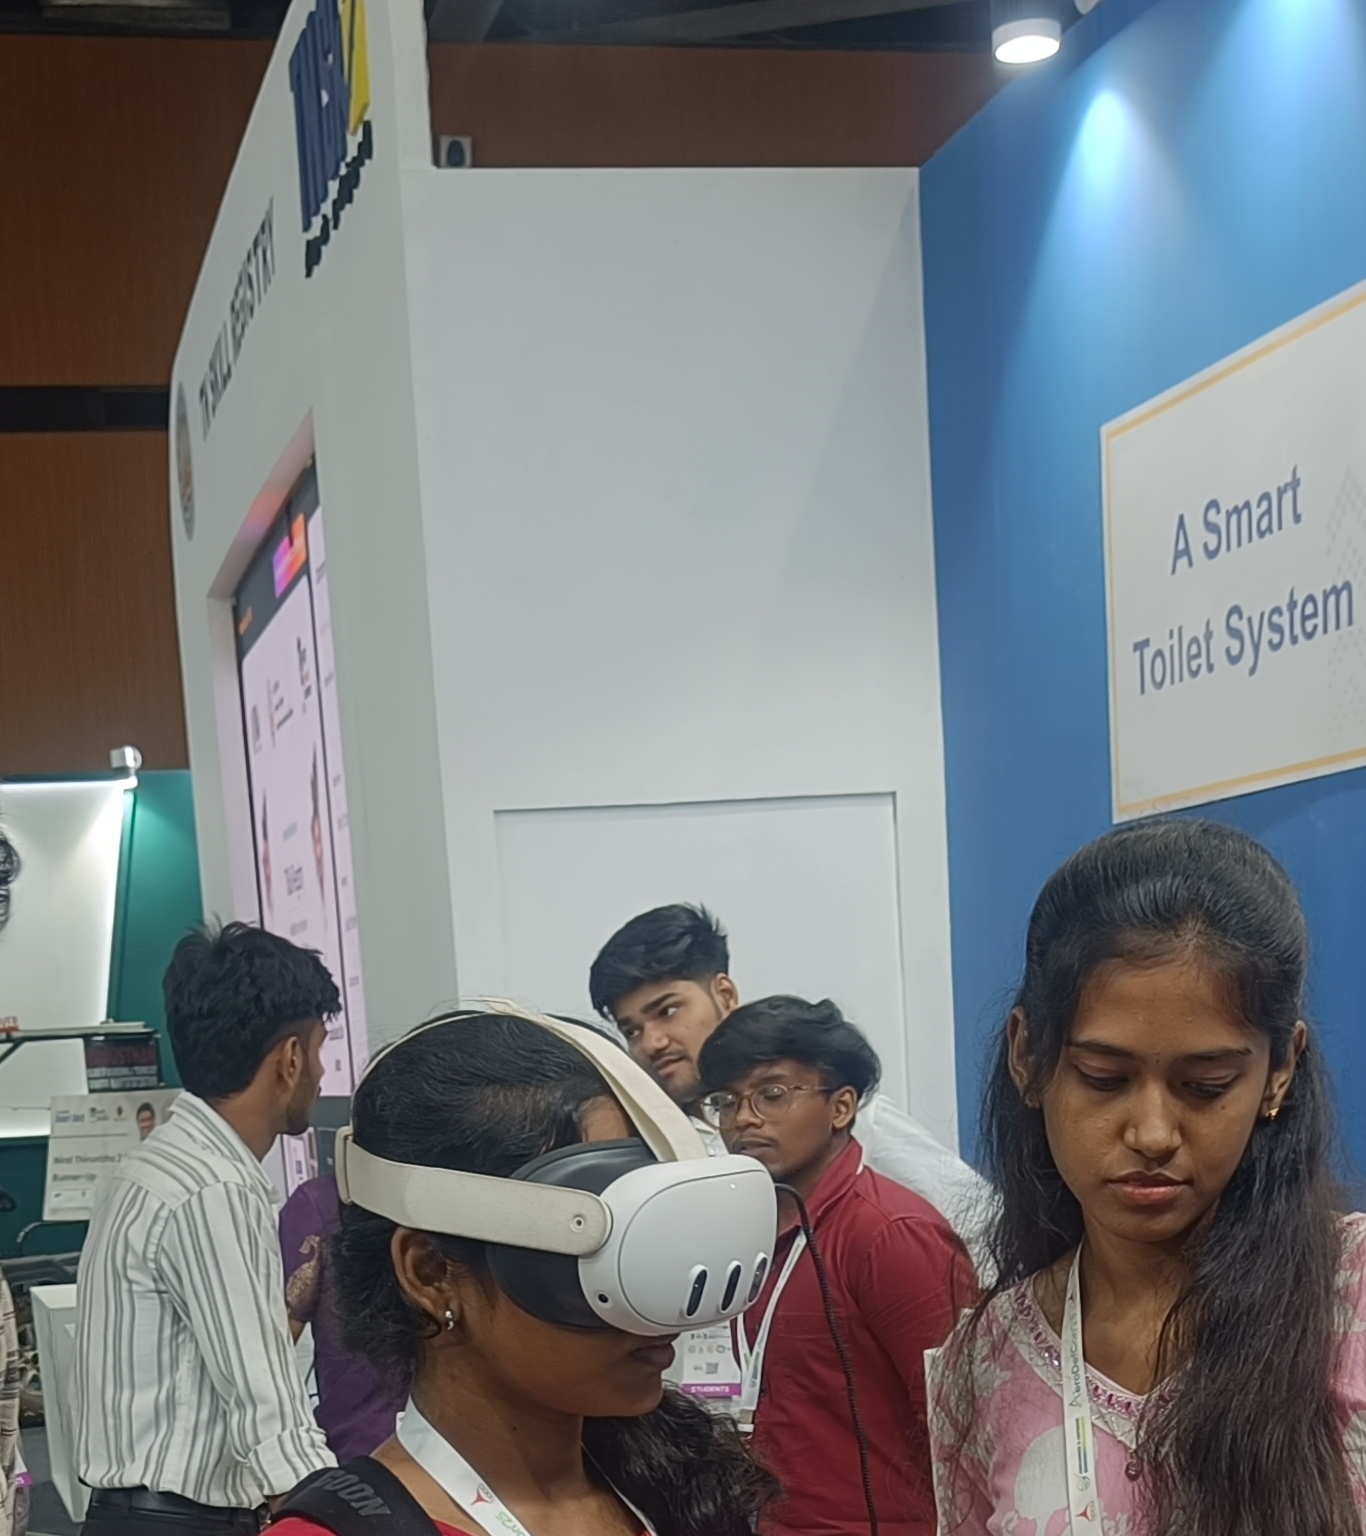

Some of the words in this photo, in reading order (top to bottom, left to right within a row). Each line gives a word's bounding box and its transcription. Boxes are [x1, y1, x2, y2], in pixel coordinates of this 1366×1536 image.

[1170, 512, 1194, 576] A
[1201, 464, 1303, 562] Smart
[1132, 616, 1215, 697] Toilet
[1224, 577, 1355, 678] System
